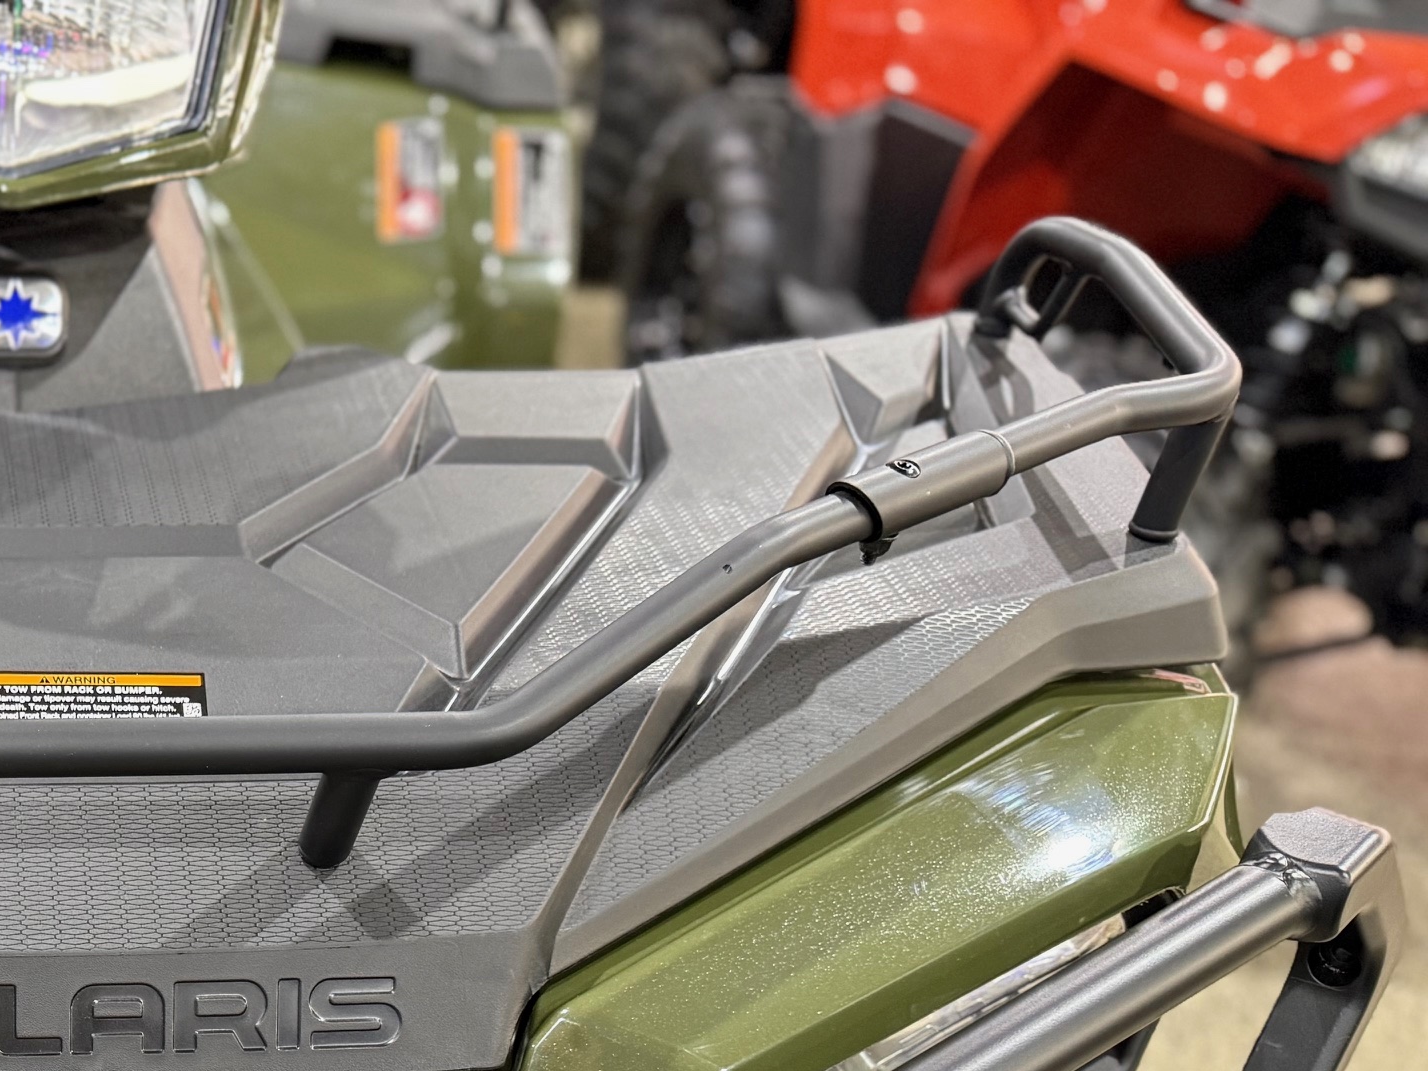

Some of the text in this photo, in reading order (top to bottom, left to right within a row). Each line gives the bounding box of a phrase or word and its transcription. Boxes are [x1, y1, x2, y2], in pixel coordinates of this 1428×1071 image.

[3, 686, 28, 694] TOW
[64, 686, 94, 694] RACK
[96, 686, 112, 694] OR
[114, 686, 162, 694] BUMPER.
[44, 694, 75, 704] tipover
[124, 695, 158, 704] causing
[28, 703, 48, 711] Tow
[50, 703, 69, 712] only
[70, 703, 91, 711] from
[152, 704, 176, 712] hitch.
